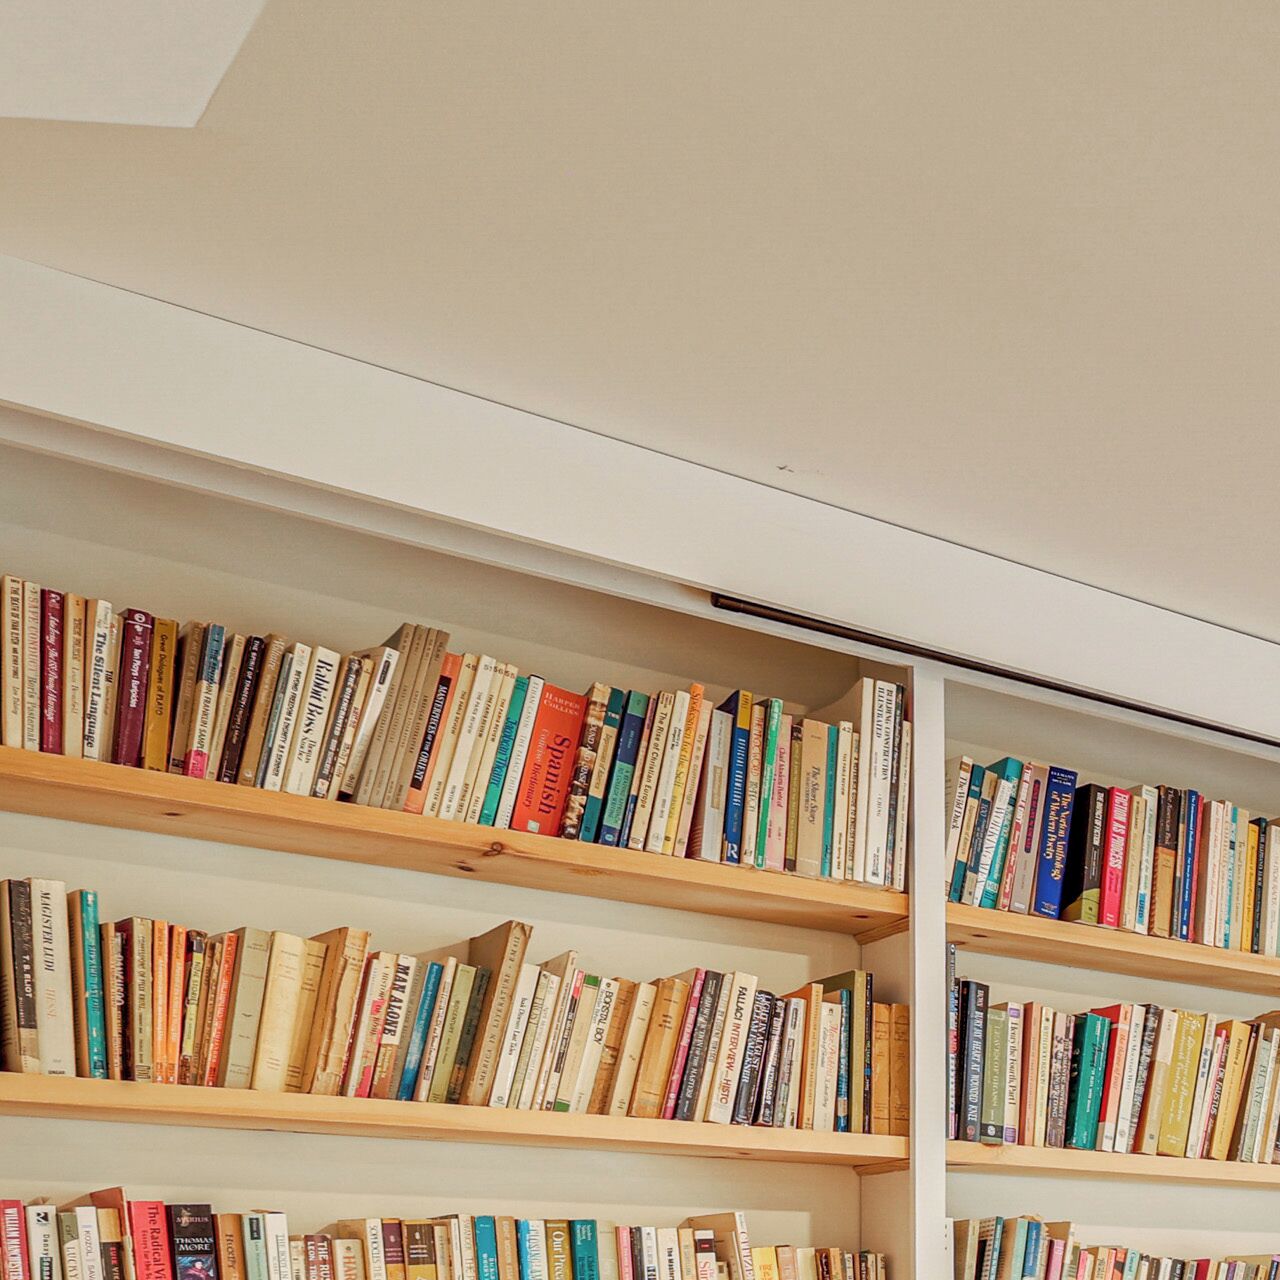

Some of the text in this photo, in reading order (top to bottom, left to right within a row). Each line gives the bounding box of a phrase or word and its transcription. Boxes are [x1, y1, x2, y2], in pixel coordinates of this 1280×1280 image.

[85, 633, 106, 748] The Silent Language
[291, 670, 302, 691] BEYOND
[302, 660, 333, 733] Rabbit Boss
[286, 692, 297, 716] FREEDOM
[427, 685, 447, 734] MASTERPIECES
[875, 687, 884, 738] ILLUSTRATED
[881, 690, 894, 780] BUILDING CONSTRUCTION
[414, 752, 430, 781] ORIENT
[538, 734, 571, 815] Spanish
[640, 712, 667, 808] The Rise of Christian Europe
[523, 763, 542, 808] Dictionary
[810, 782, 818, 802] Short
[809, 805, 817, 824] Story
[1110, 792, 1129, 869] FICTION AS PROCESS
[40, 891, 55, 972] MAGISTER LUDI
[383, 965, 410, 1036] MAN ALONE
[593, 991, 613, 1045] BORSTAL BOY
[975, 1011, 984, 1027] BURY
[727, 986, 747, 1070] FALLACI INTERVIEW
[742, 992, 762, 1082] WILLIAM FAULKNER
[751, 995, 772, 1070] LIGHT IN AUGUST
[972, 1062, 981, 1071] AT
[973, 1041, 982, 1061] HEART
[970, 1075, 980, 1102] WOUNDED
[968, 1105, 978, 1121] KNEE
[148, 1206, 159, 1225] The
[84, 1230, 92, 1256] KOZOL
[150, 1228, 162, 1266] Radical
[317, 1241, 328, 1262] THE
[552, 1231, 565, 1253] Our
[66, 1247, 78, 1279] LUCKY
